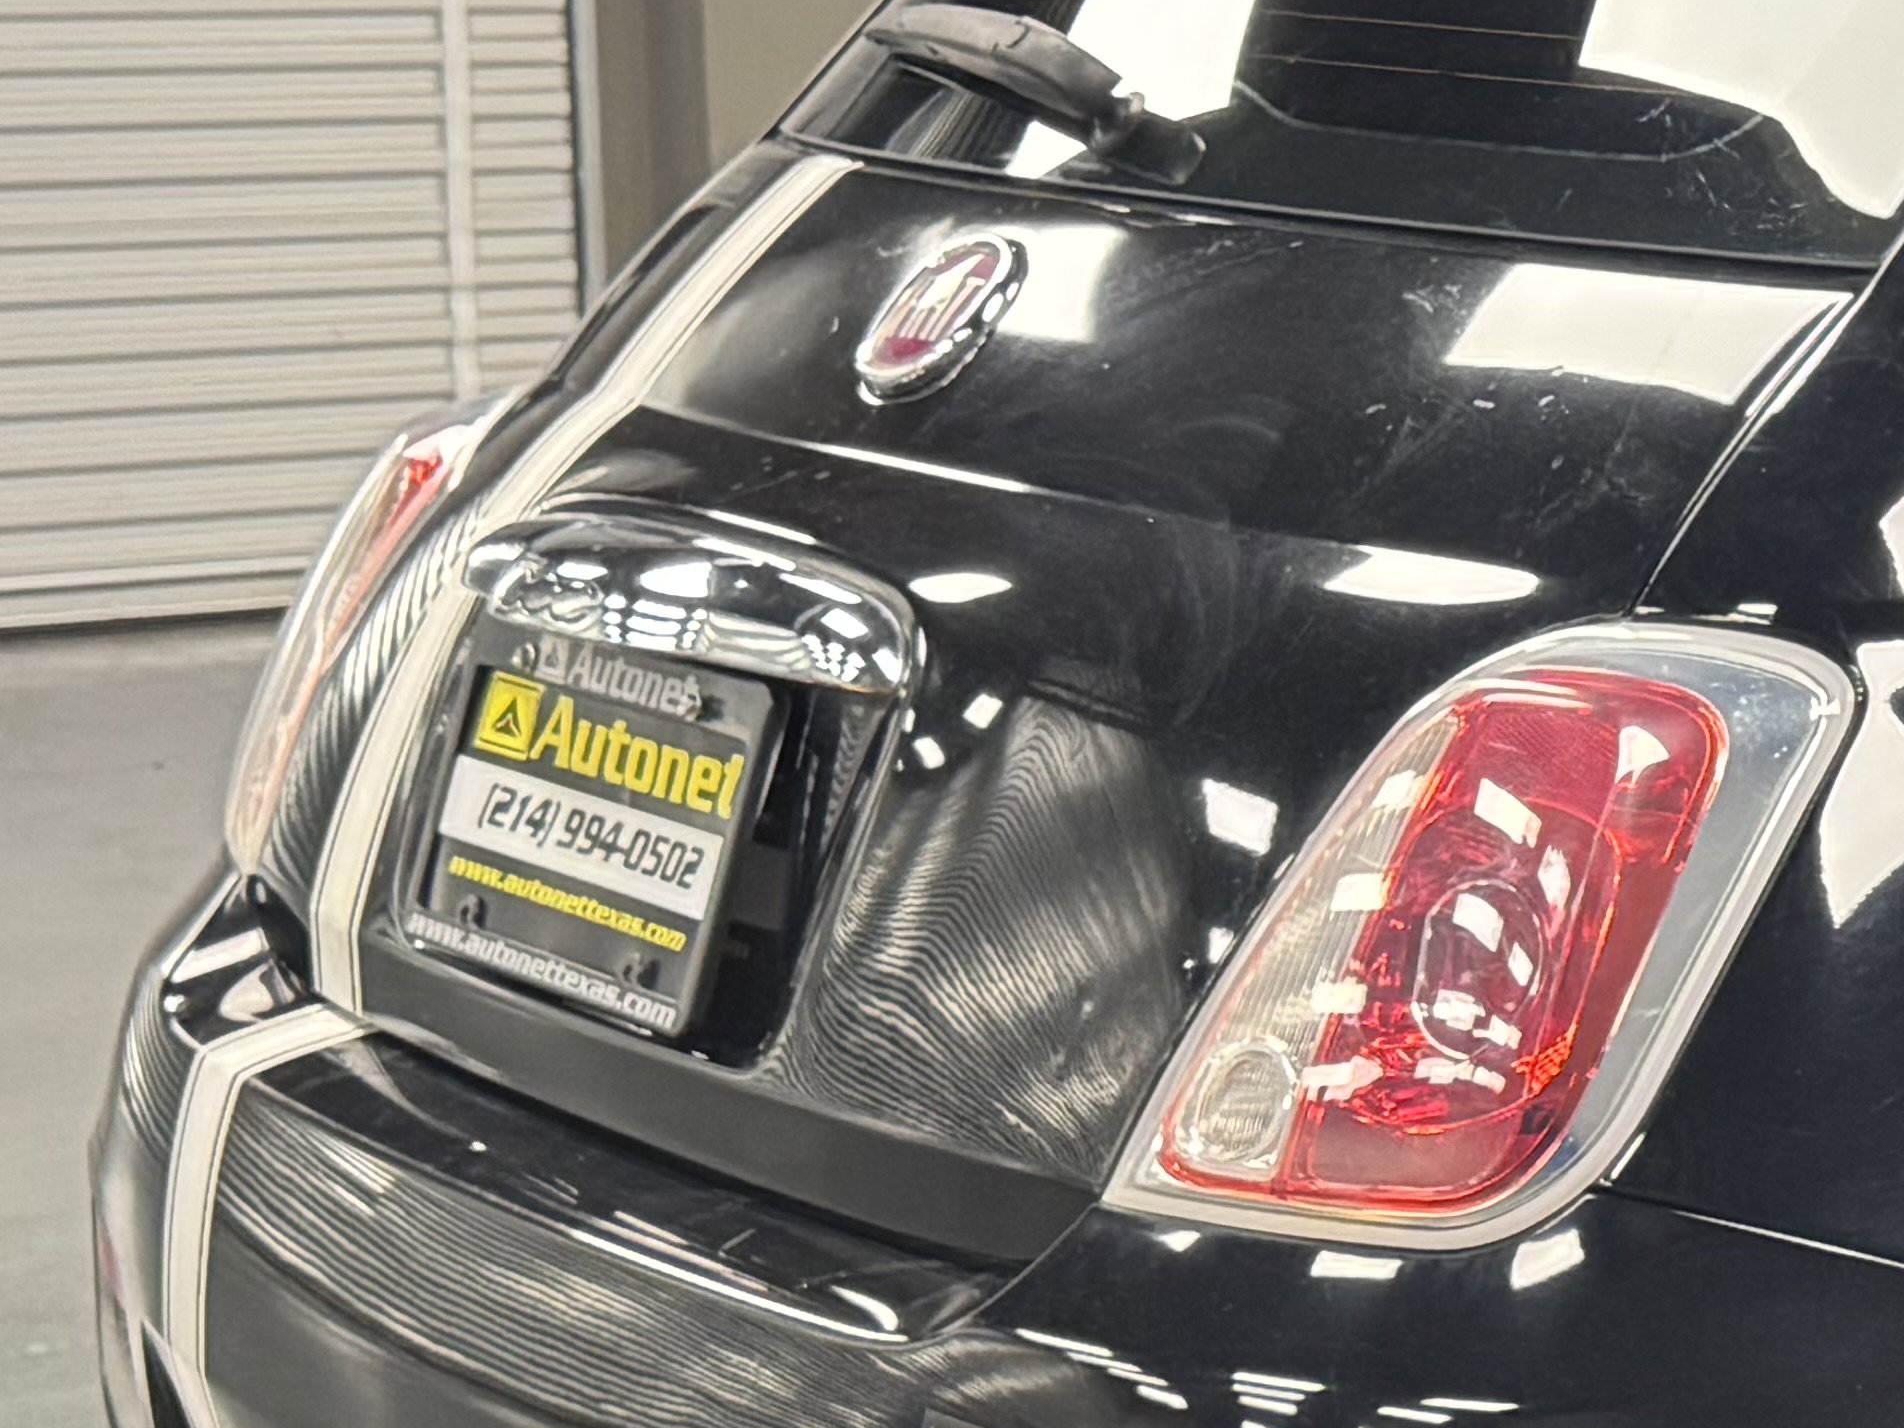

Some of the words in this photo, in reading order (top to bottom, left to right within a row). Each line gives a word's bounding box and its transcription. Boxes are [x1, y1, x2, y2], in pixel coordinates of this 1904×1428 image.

[530, 694, 745, 820] Autonet
[478, 783, 561, 848] (214)
[556, 808, 704, 890] 994-0502
[449, 856, 687, 952] www.autonettexas.com
[406, 912, 677, 1029] www.autonettexas.com
